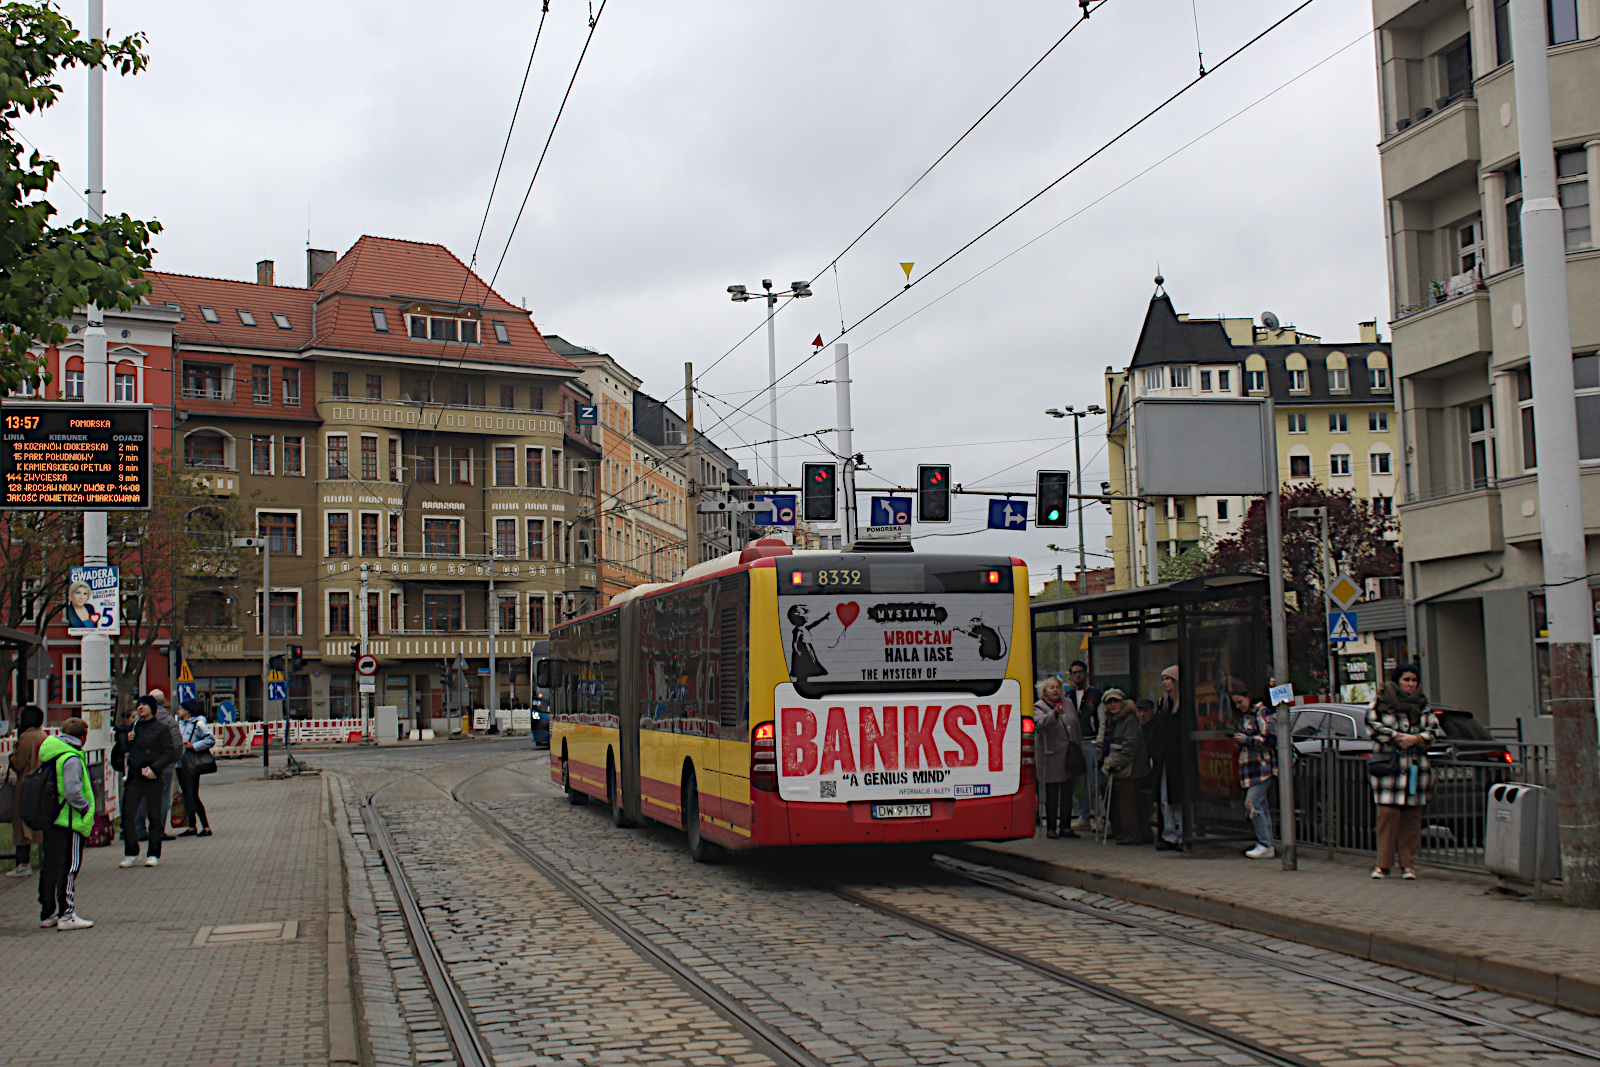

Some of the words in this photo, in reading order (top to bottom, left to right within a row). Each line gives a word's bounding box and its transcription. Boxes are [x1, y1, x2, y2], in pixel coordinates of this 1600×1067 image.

[6, 416, 40, 429] 13:57
[70, 420, 111, 428] POMORSKA
[24, 442, 62, 450] KOZANÓW
[63, 443, 108, 451] (DOKERSKA)
[118, 443, 124, 451] 2
[126, 443, 138, 451] min
[46, 453, 94, 461] POŁUDNIOWY
[24, 462, 79, 471] KAMIEŃSKIEGO
[81, 463, 112, 472] (PĘTLA)
[6, 473, 22, 481] 144
[24, 473, 68, 482] ZWYCIĘSKA
[84, 483, 105, 492] DWÓR
[7, 493, 38, 502] JAKOŚĆ
[86, 494, 140, 502] UMIARKOWANA
[72, 568, 114, 582] GWADERA
[818, 570, 861, 585] 8332
[92, 577, 117, 589] URLEP
[101, 608, 114, 627] 5
[878, 609, 936, 619] WYSTAWA
[884, 630, 952, 646] WROCŁAW
[884, 648, 919, 662] HALA
[924, 647, 954, 662] IASE
[1346, 662, 1368, 672] TANDYR
[862, 668, 878, 680] THE
[882, 667, 922, 680] MYSTERY
[926, 668, 937, 679] OF
[781, 704, 1012, 777] BANKSY
[864, 771, 908, 786] GENIUS
[897, 804, 928, 816] 917KF
